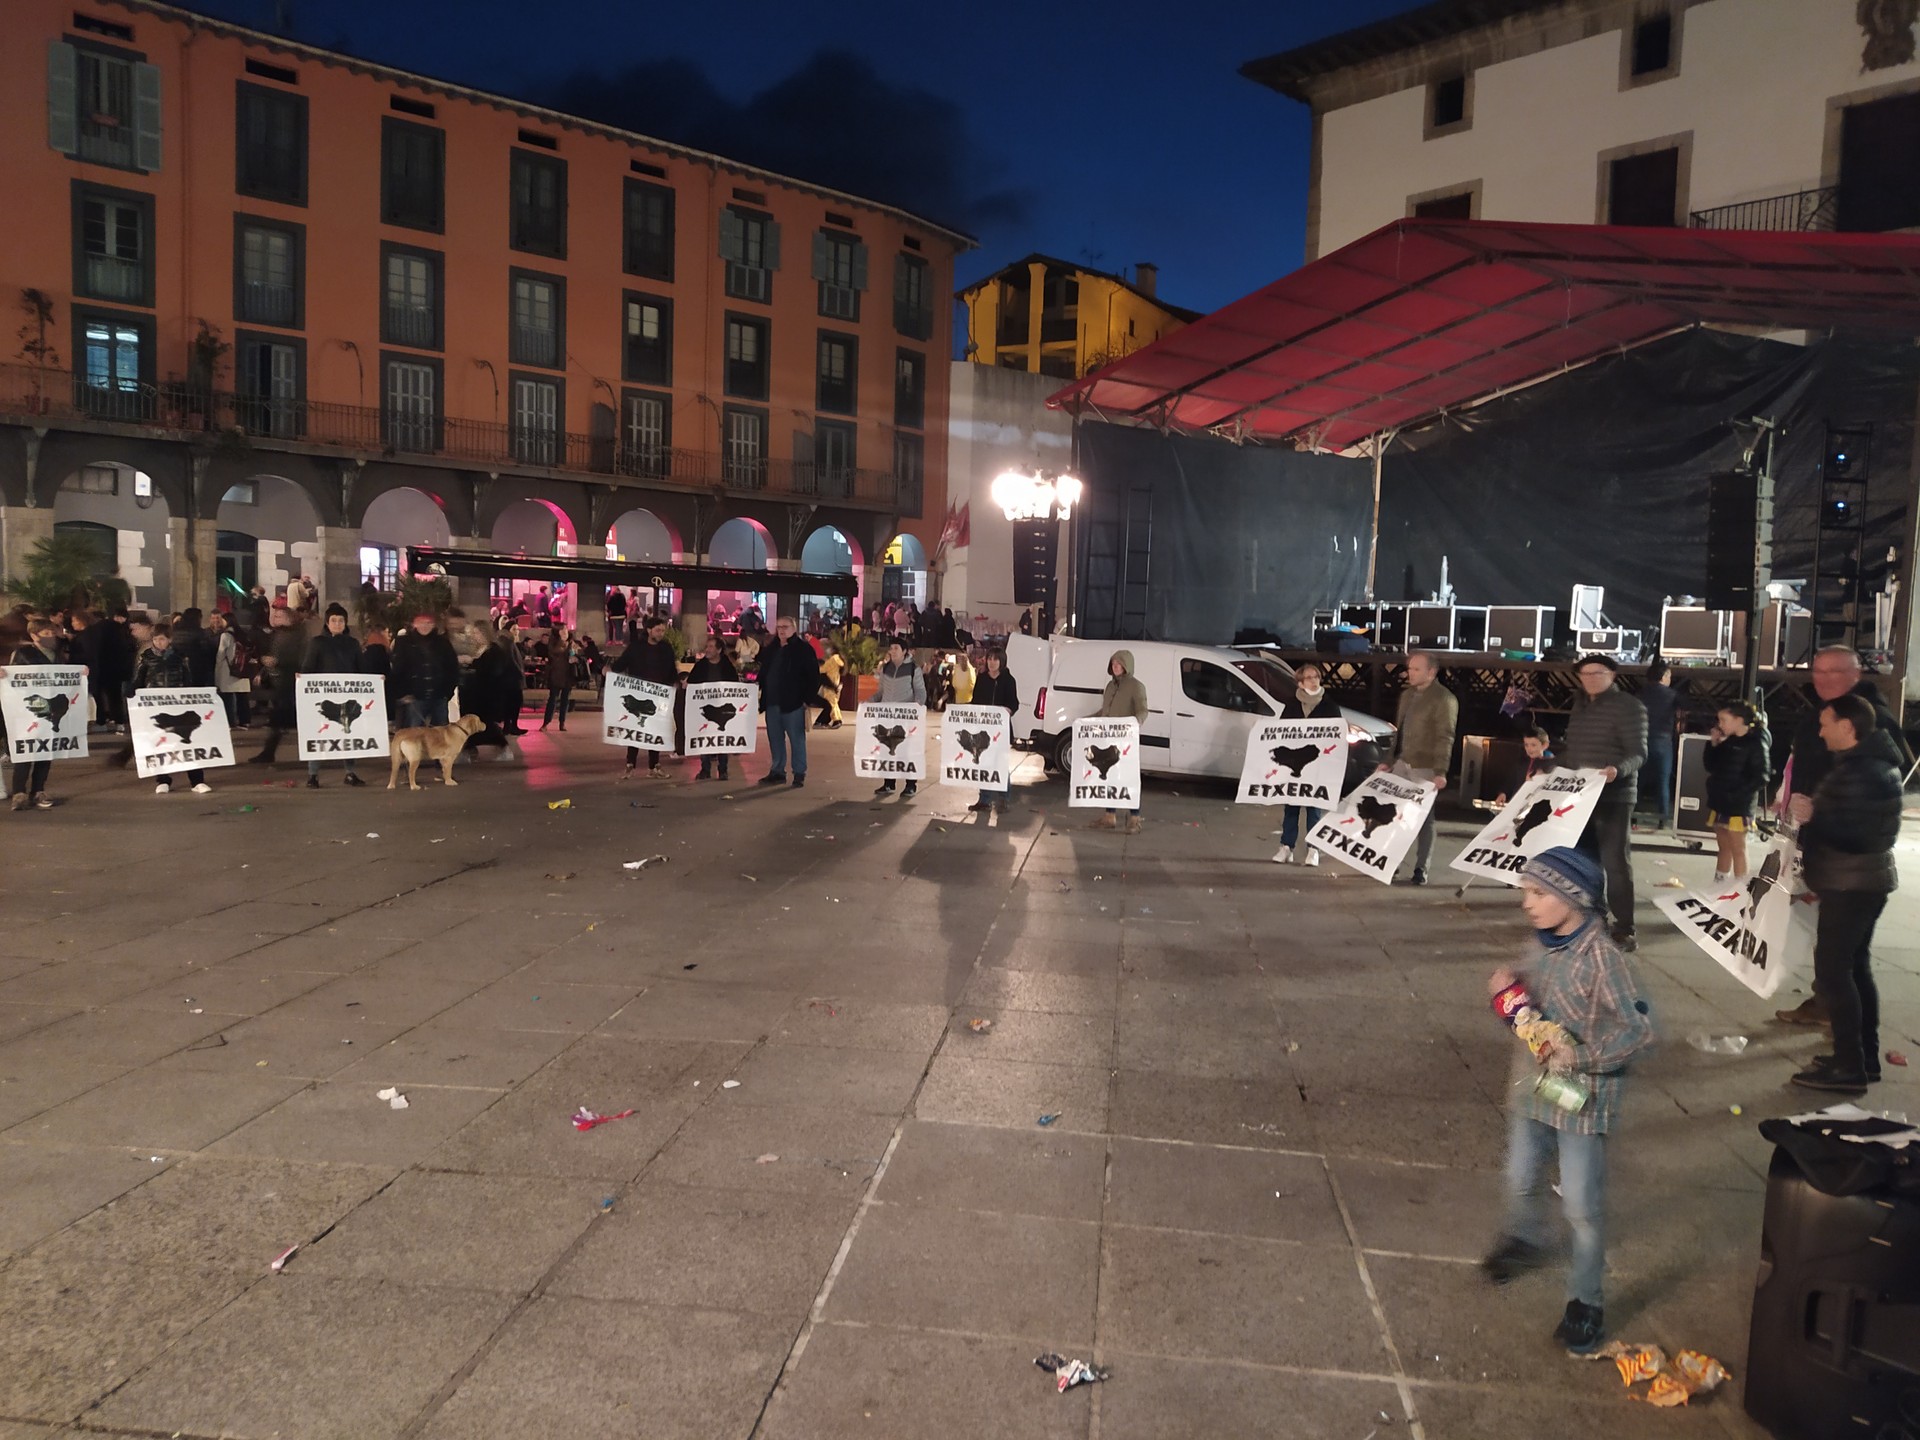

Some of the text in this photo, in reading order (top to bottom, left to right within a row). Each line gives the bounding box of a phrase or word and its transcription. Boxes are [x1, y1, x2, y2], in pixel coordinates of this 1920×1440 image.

[14, 672, 80, 680] EUSKAL PRESO
[11, 680, 28, 688] ETA
[307, 680, 342, 688] EUSKAL
[613, 680, 670, 699] ETA IHESLARIAK
[616, 675, 669, 694] EUSKAL PRESO
[695, 687, 721, 695] EUSKAL
[140, 694, 177, 702] EUSKAL
[866, 706, 892, 714] EUSKAL
[878, 713, 919, 721] IHESLARIAK
[951, 710, 1002, 719] EUSKAL PRESO
[607, 726, 665, 745] ETXERA
[1260, 732, 1341, 741] ETA IHESLARIAK
[1264, 726, 1302, 734] EUSKAL
[15, 736, 79, 754] ETXERA
[306, 738, 379, 753] ETXERA
[690, 736, 747, 749] ETXERA
[146, 746, 223, 769] ETXERA
[861, 759, 917, 773] ETXERA
[946, 767, 1001, 784] ETXERA
[1075, 786, 1131, 801] ETXERA
[1248, 782, 1330, 801] ETXERA
[1316, 825, 1389, 871] ETXERA
[1464, 848, 1528, 874] ETXER
